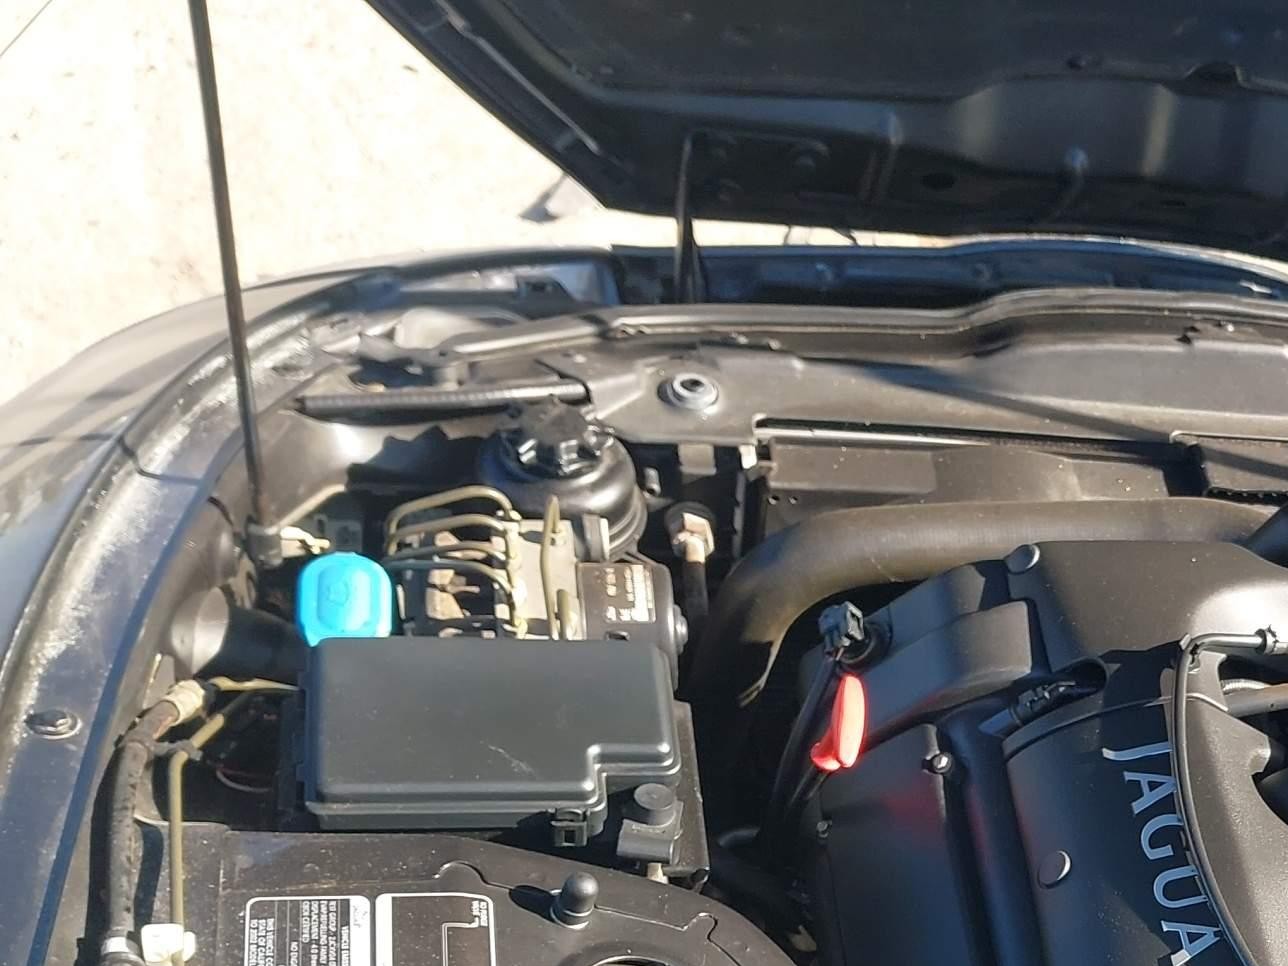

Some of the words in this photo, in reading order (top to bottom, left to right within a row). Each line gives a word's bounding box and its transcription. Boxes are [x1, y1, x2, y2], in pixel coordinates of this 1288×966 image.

[250, 919, 257, 928] TO
[258, 919, 266, 936] STATE
[266, 918, 274, 930] THIS
[302, 916, 310, 942] CERTIFIED
[311, 901, 319, 939] DISPLACEMENT
[258, 937, 265, 946] OF
[266, 931, 274, 956] VEHICLE
[291, 941, 298, 951] NO
[341, 925, 349, 949] VEHICLE
[248, 944, 257, 966] MODEL
